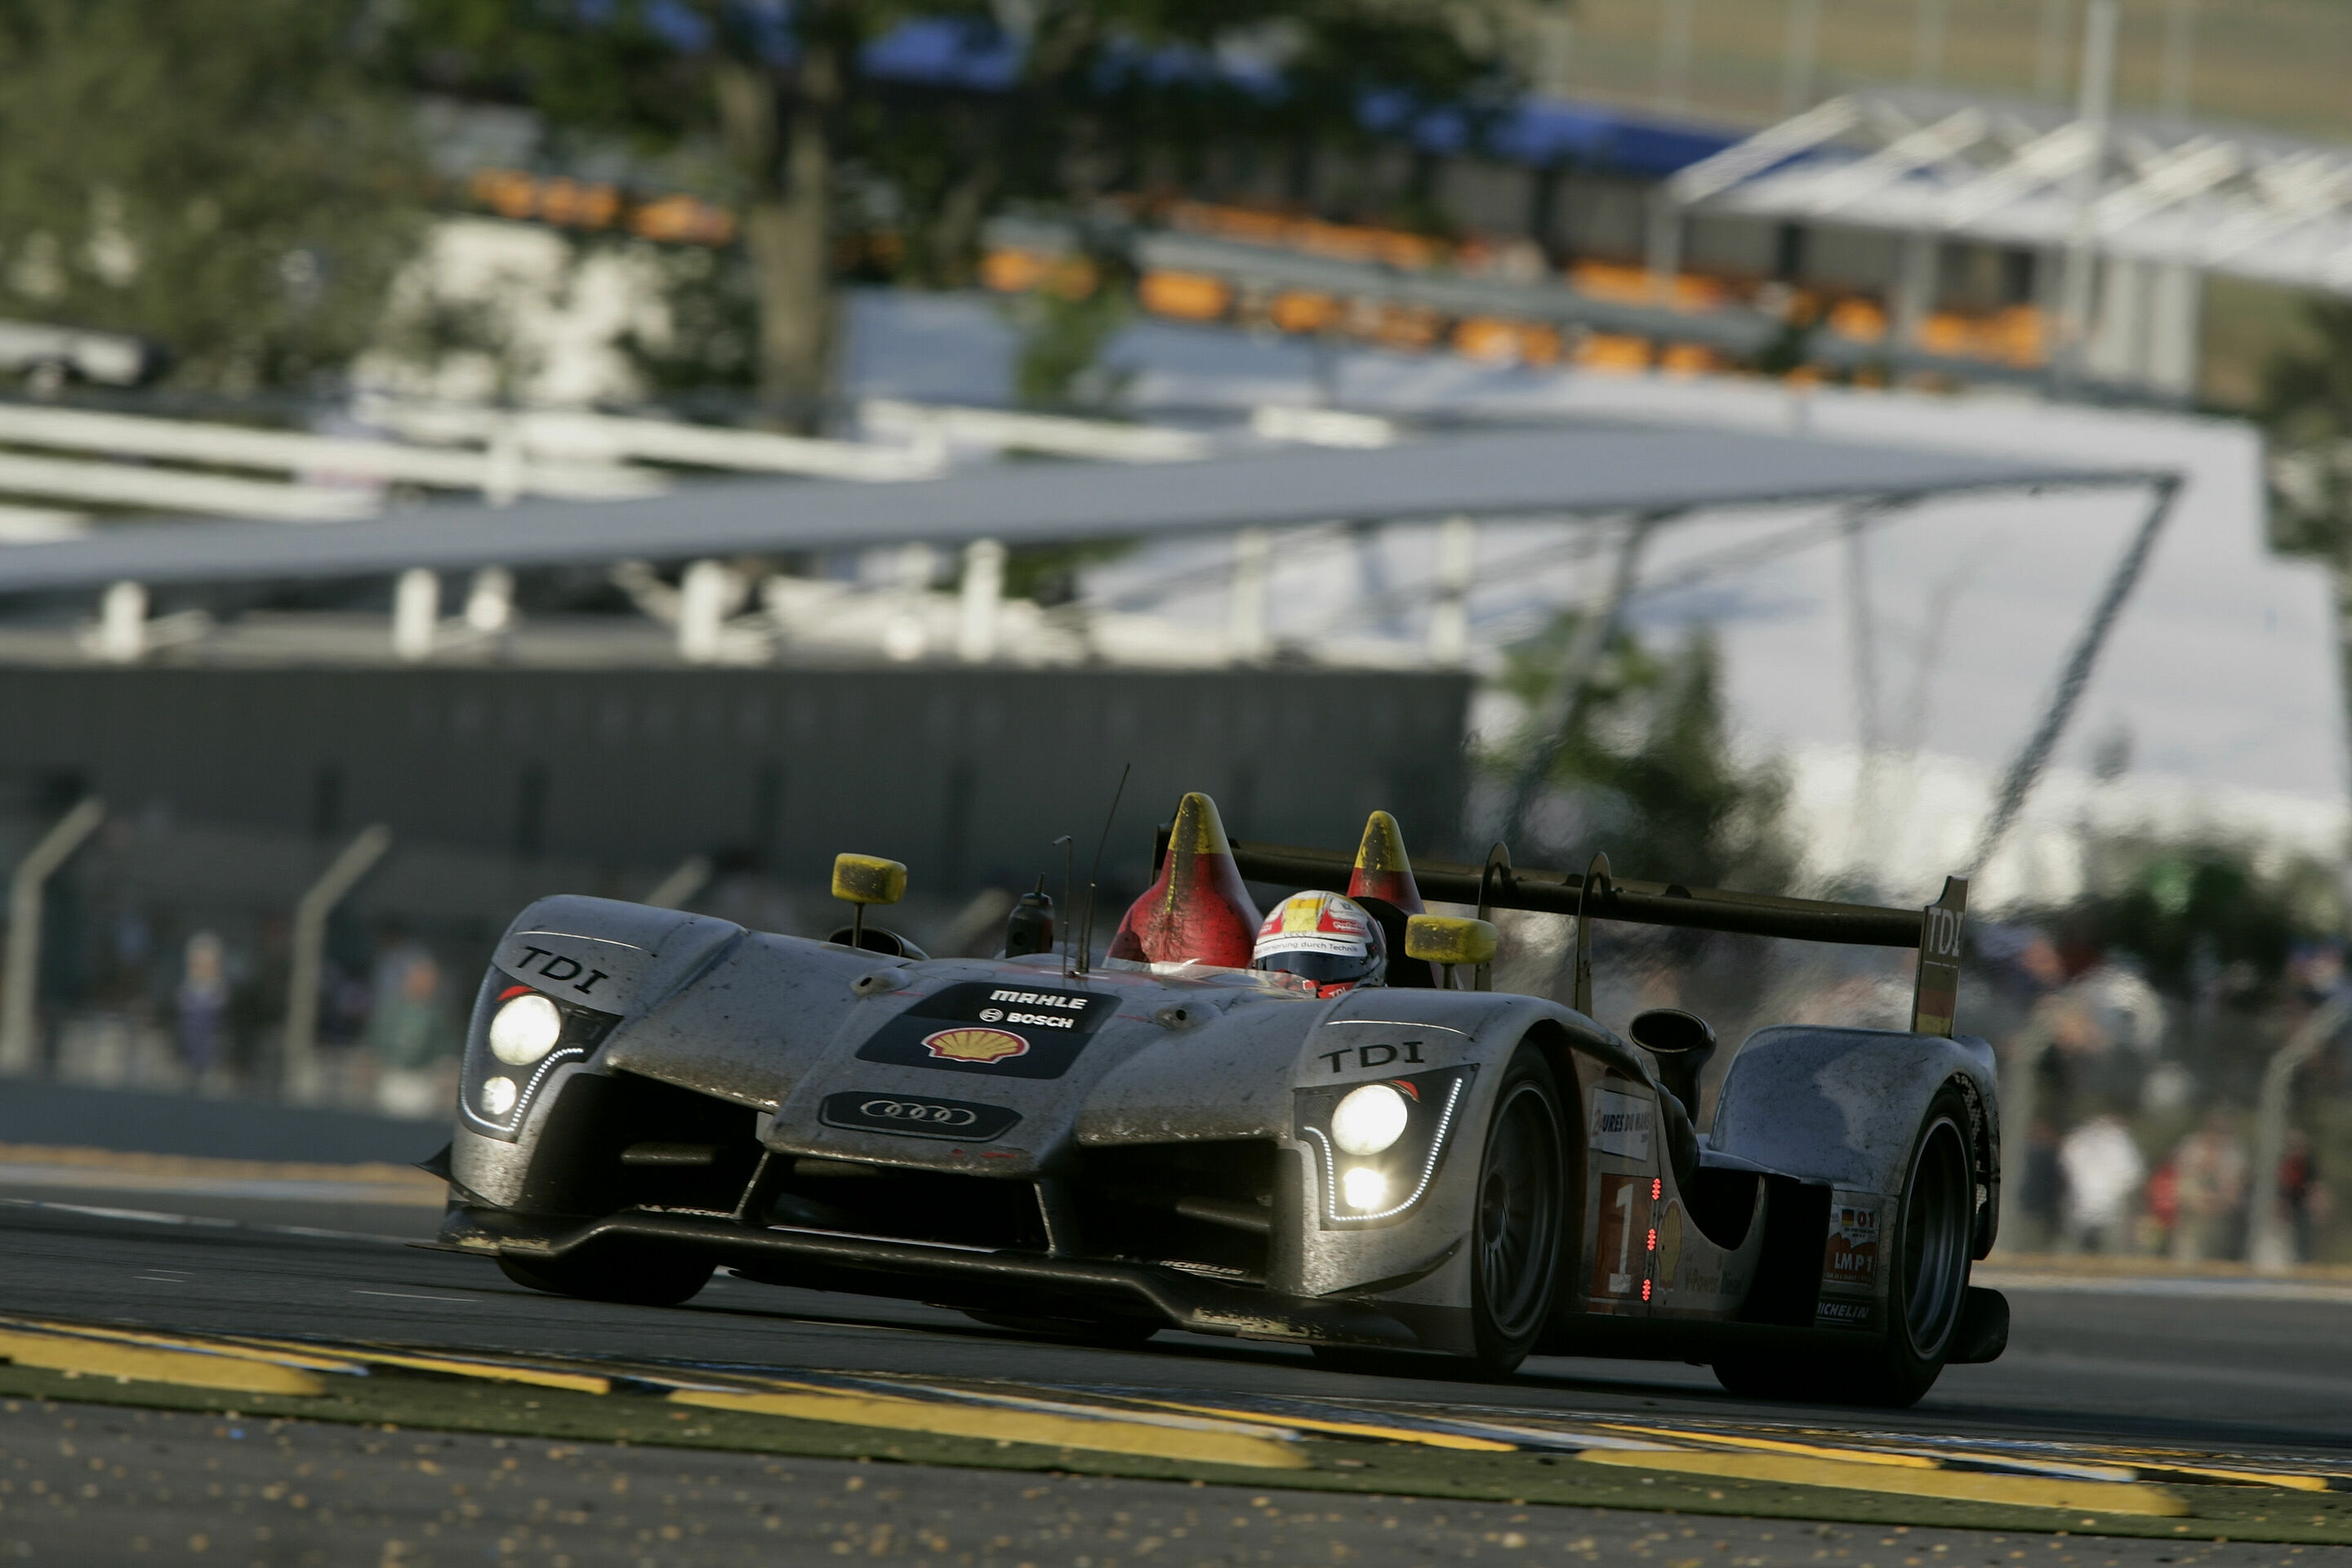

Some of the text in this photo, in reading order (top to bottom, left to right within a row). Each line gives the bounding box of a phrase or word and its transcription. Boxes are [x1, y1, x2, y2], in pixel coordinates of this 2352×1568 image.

[1928, 907, 1965, 957] TDI
[1329, 942, 1358, 952] Technik
[515, 946, 608, 995] TDI
[989, 989, 1088, 1010] MAHLE
[1005, 1012, 1075, 1029] BOSCH
[1318, 1040, 1425, 1074] TDI
[1857, 1210, 1875, 1228] 01
[1608, 1183, 1634, 1294] 1
